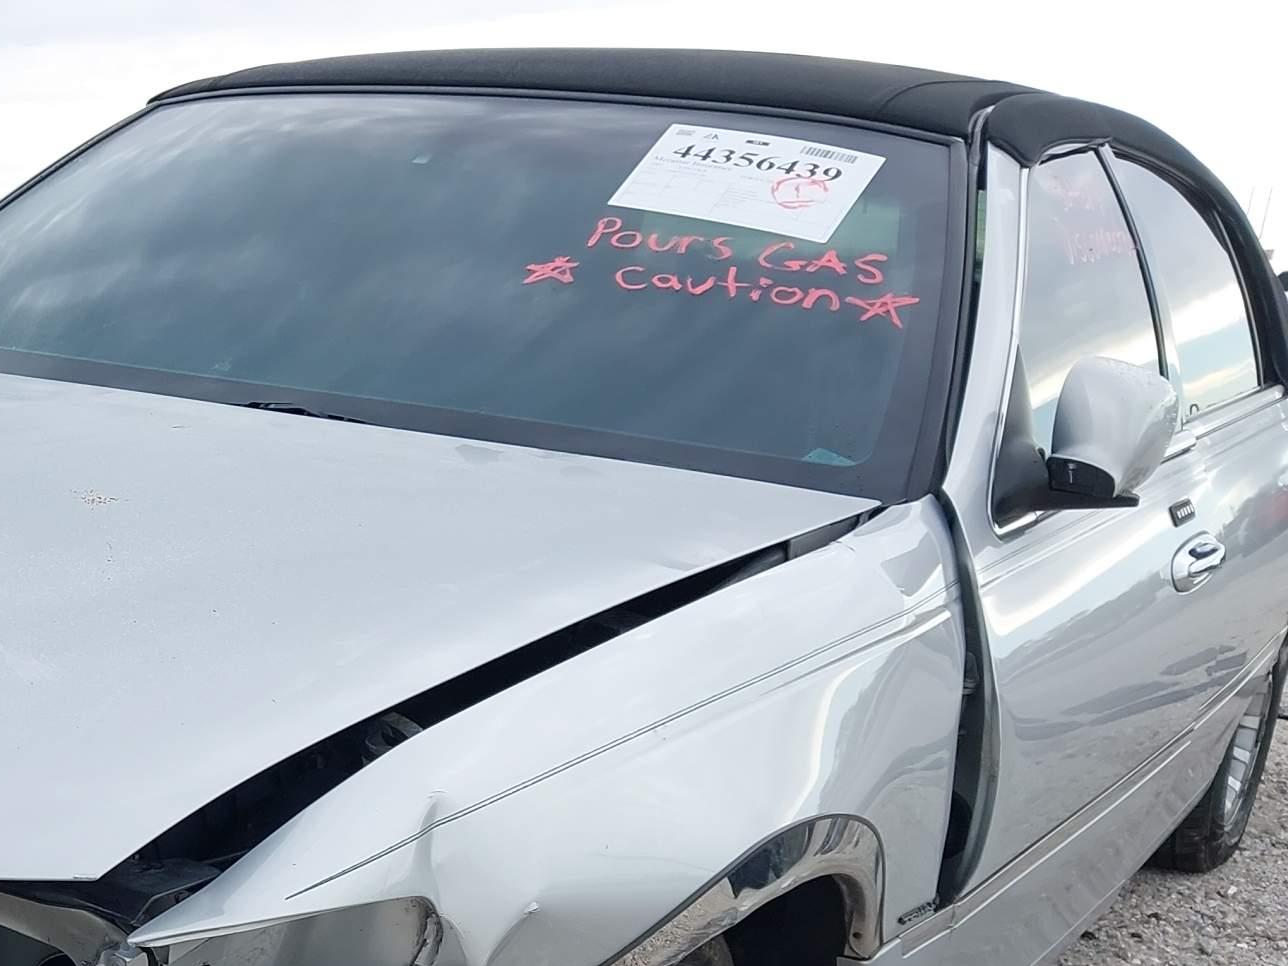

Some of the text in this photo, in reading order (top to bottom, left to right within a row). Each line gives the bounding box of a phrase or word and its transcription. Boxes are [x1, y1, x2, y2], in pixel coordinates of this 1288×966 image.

[673, 144, 842, 182] 44356439
[587, 216, 888, 284] Pours GAS
